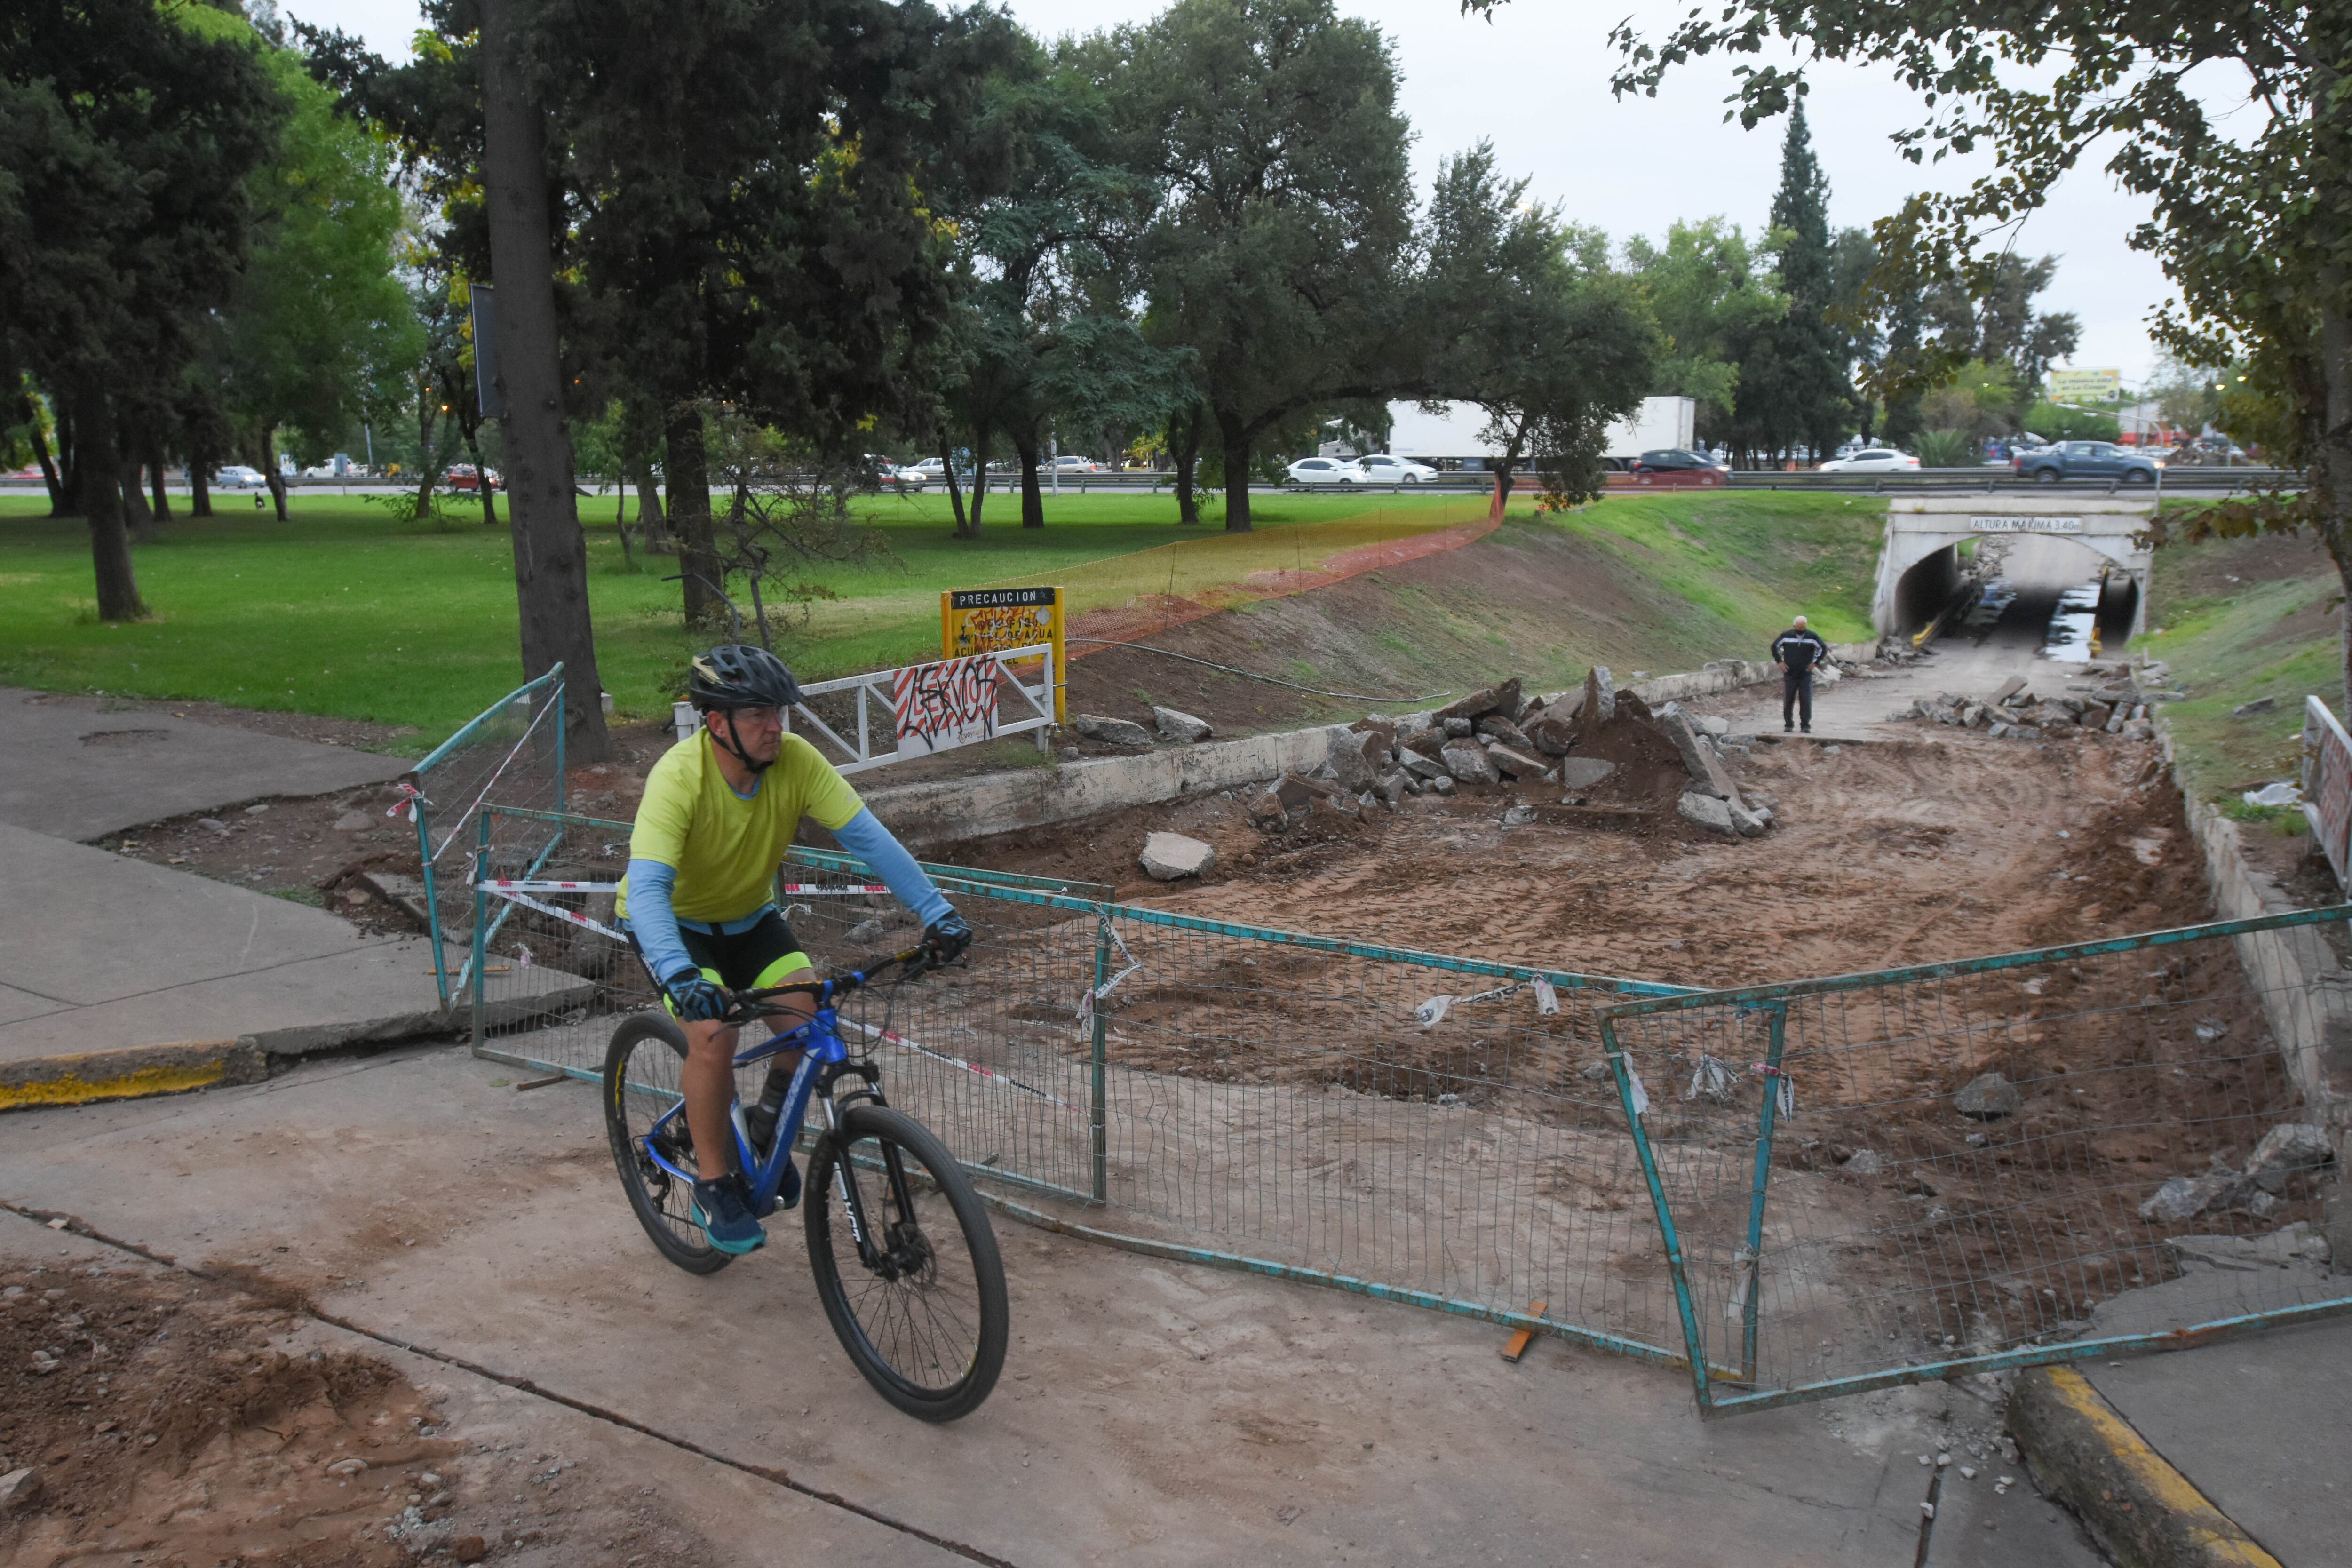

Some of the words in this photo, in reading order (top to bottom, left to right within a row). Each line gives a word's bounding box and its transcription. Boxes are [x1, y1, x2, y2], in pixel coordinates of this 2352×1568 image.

[1973, 519, 2009, 529] ALTURA
[960, 590, 1036, 605] PRECAUCION
[1008, 630, 1020, 641] DE
[1025, 628, 1053, 639] AGUA
[912, 675, 982, 716] DESVIO
